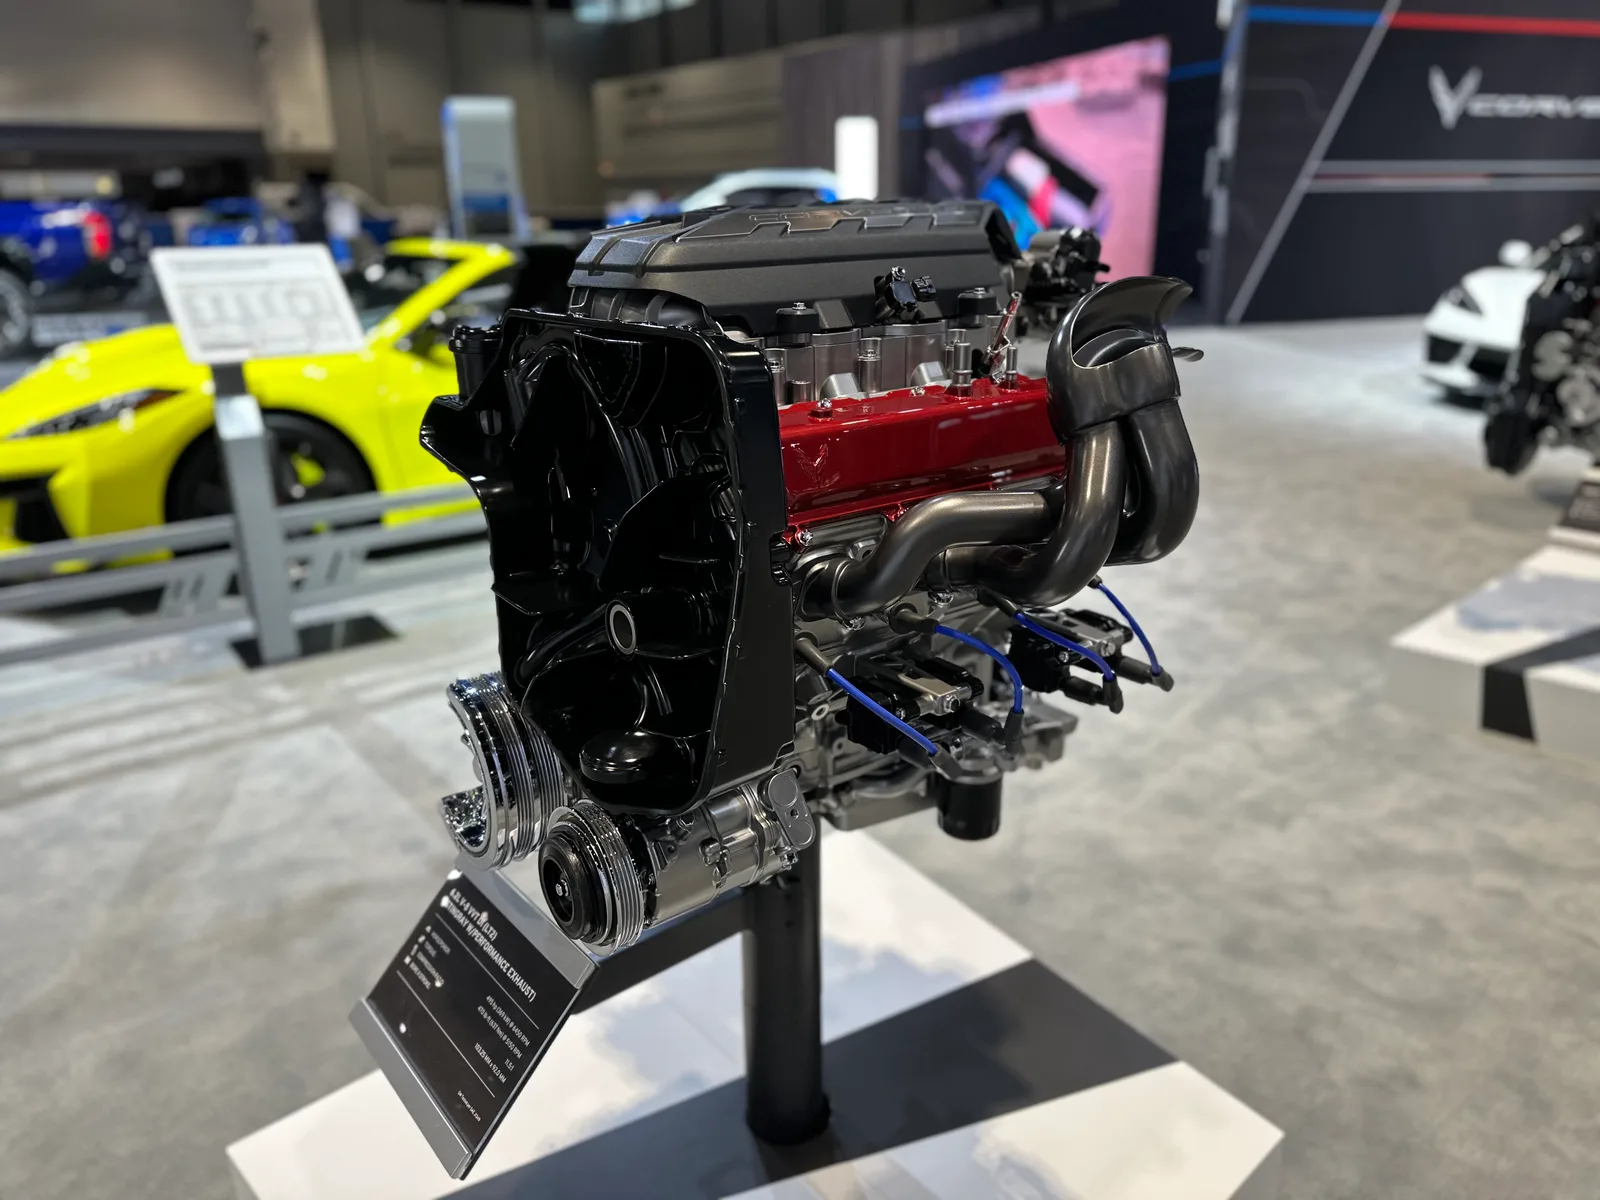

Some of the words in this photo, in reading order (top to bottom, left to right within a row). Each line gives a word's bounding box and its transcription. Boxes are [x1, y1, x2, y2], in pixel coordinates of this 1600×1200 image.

[481, 921, 498, 942] (LT2)
[464, 922, 510, 974] W/PERFORMANCE
[505, 966, 536, 1003] EXHAUST)
